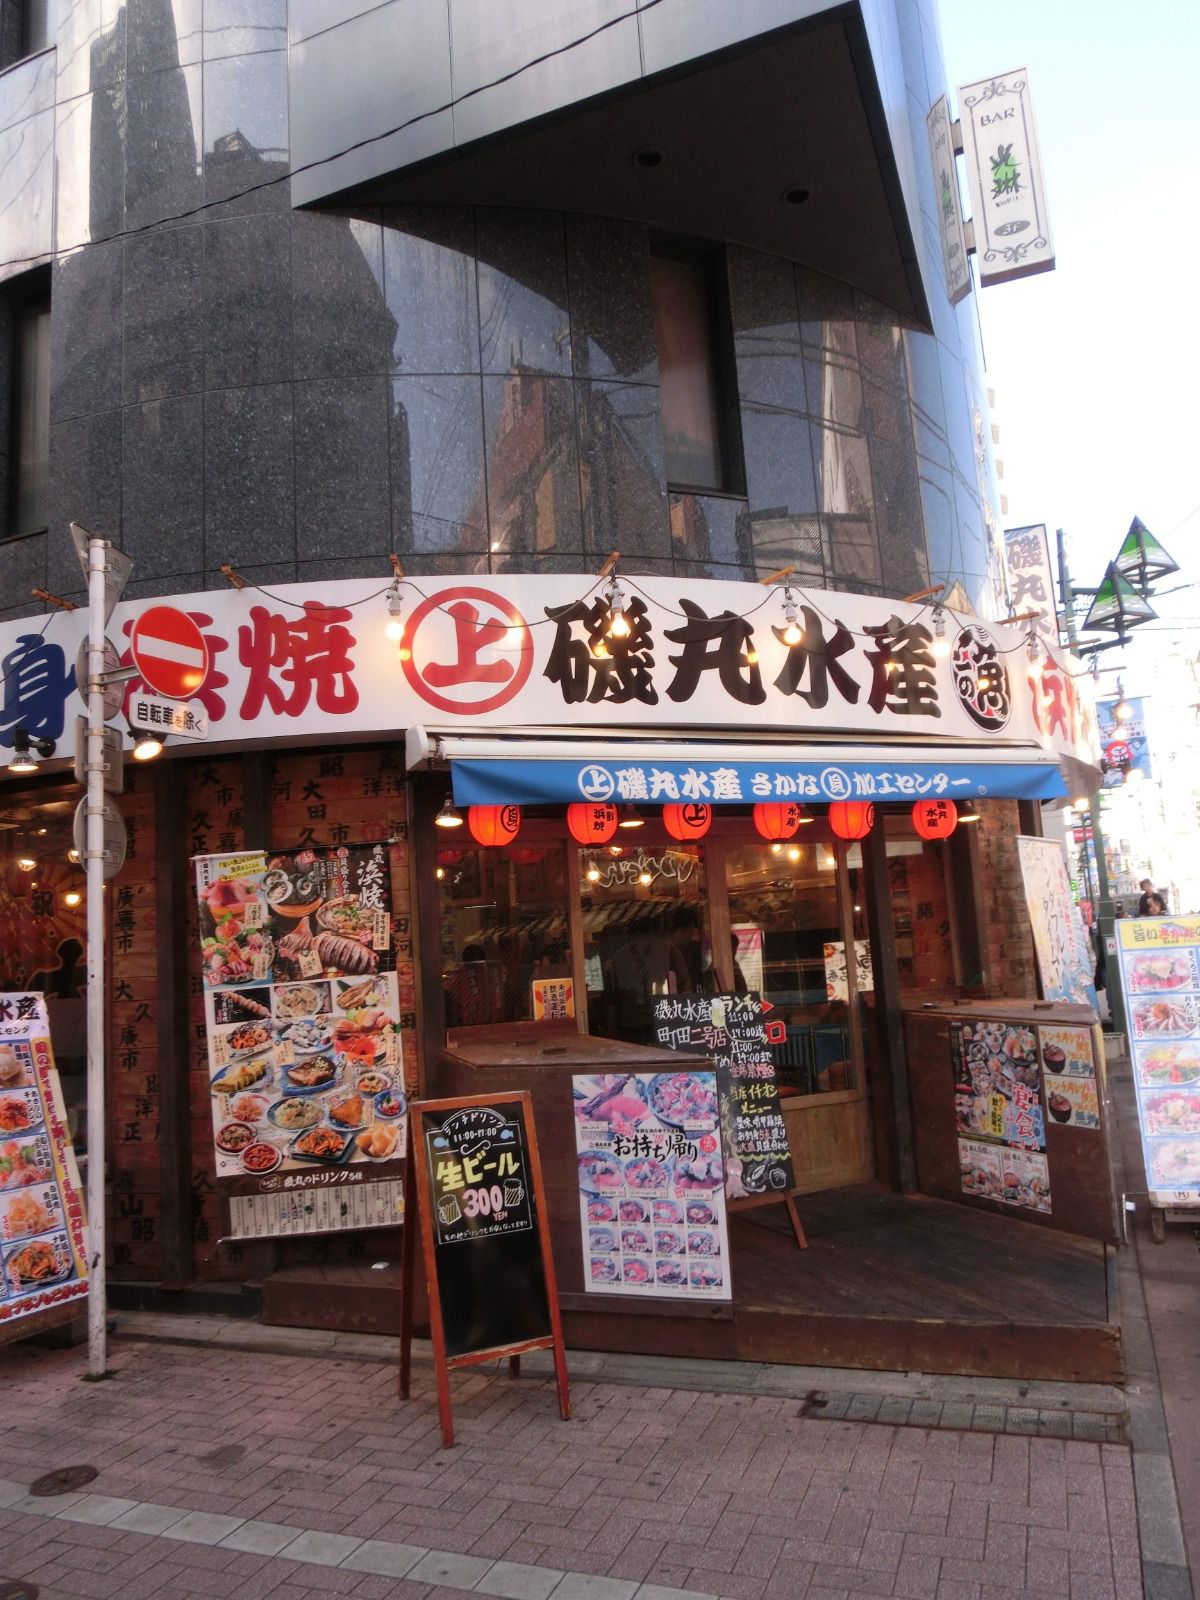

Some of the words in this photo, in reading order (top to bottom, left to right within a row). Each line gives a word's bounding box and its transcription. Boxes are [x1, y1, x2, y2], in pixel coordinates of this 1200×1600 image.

[980, 107, 1015, 127] BAR
[544, 595, 941, 719] 磯丸水産
[137, 701, 201, 733] 自転車を除く
[615, 767, 742, 801] 磯丸水産
[751, 773, 821, 797] さかな
[853, 772, 971, 797] 加工センター
[356, 859, 385, 909] 浜焼
[655, 998, 713, 1024] 磯丸水産
[719, 993, 754, 1012] ランチ
[728, 1011, 754, 1022] 11:00
[657, 1025, 727, 1049] 町田二号店
[730, 1083, 778, 1102] 当店イチオシ
[741, 1101, 772, 1115] メニュー
[614, 1133, 698, 1162] お持ち帰り
[436, 1150, 520, 1191] 生ビール
[462, 1185, 503, 1217] 300
[493, 1210, 508, 1221] YEN
